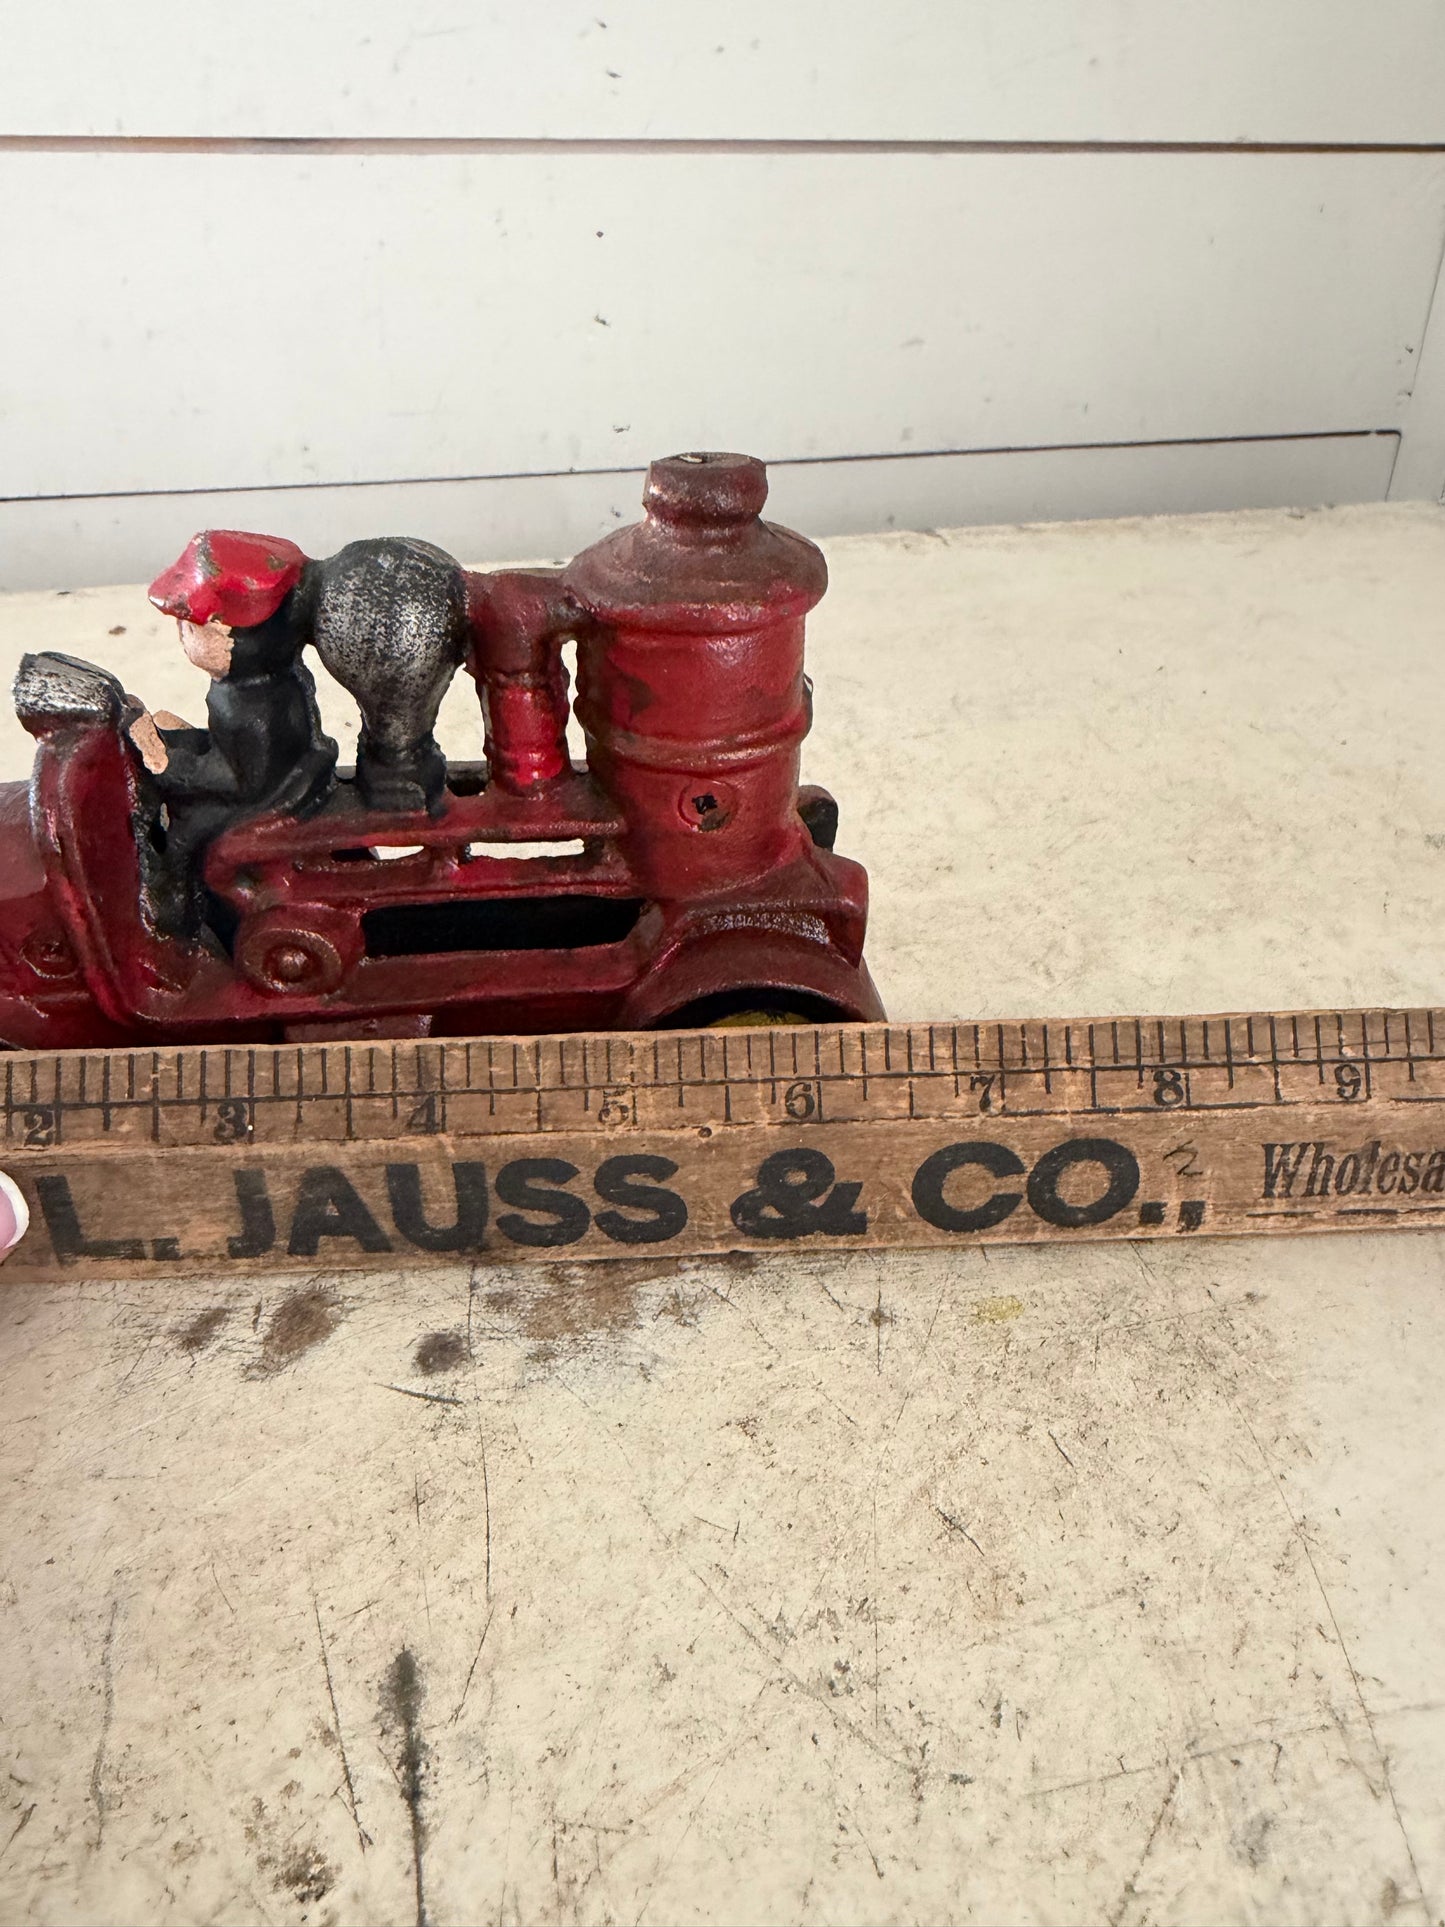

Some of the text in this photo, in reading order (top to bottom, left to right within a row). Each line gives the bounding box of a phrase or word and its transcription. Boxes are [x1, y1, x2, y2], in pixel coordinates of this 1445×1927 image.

[23, 1064, 1361, 1146] 2 3 4 5 6 7 8 9
[227, 1153, 688, 1259] JAUSS
[730, 1148, 867, 1239] &
